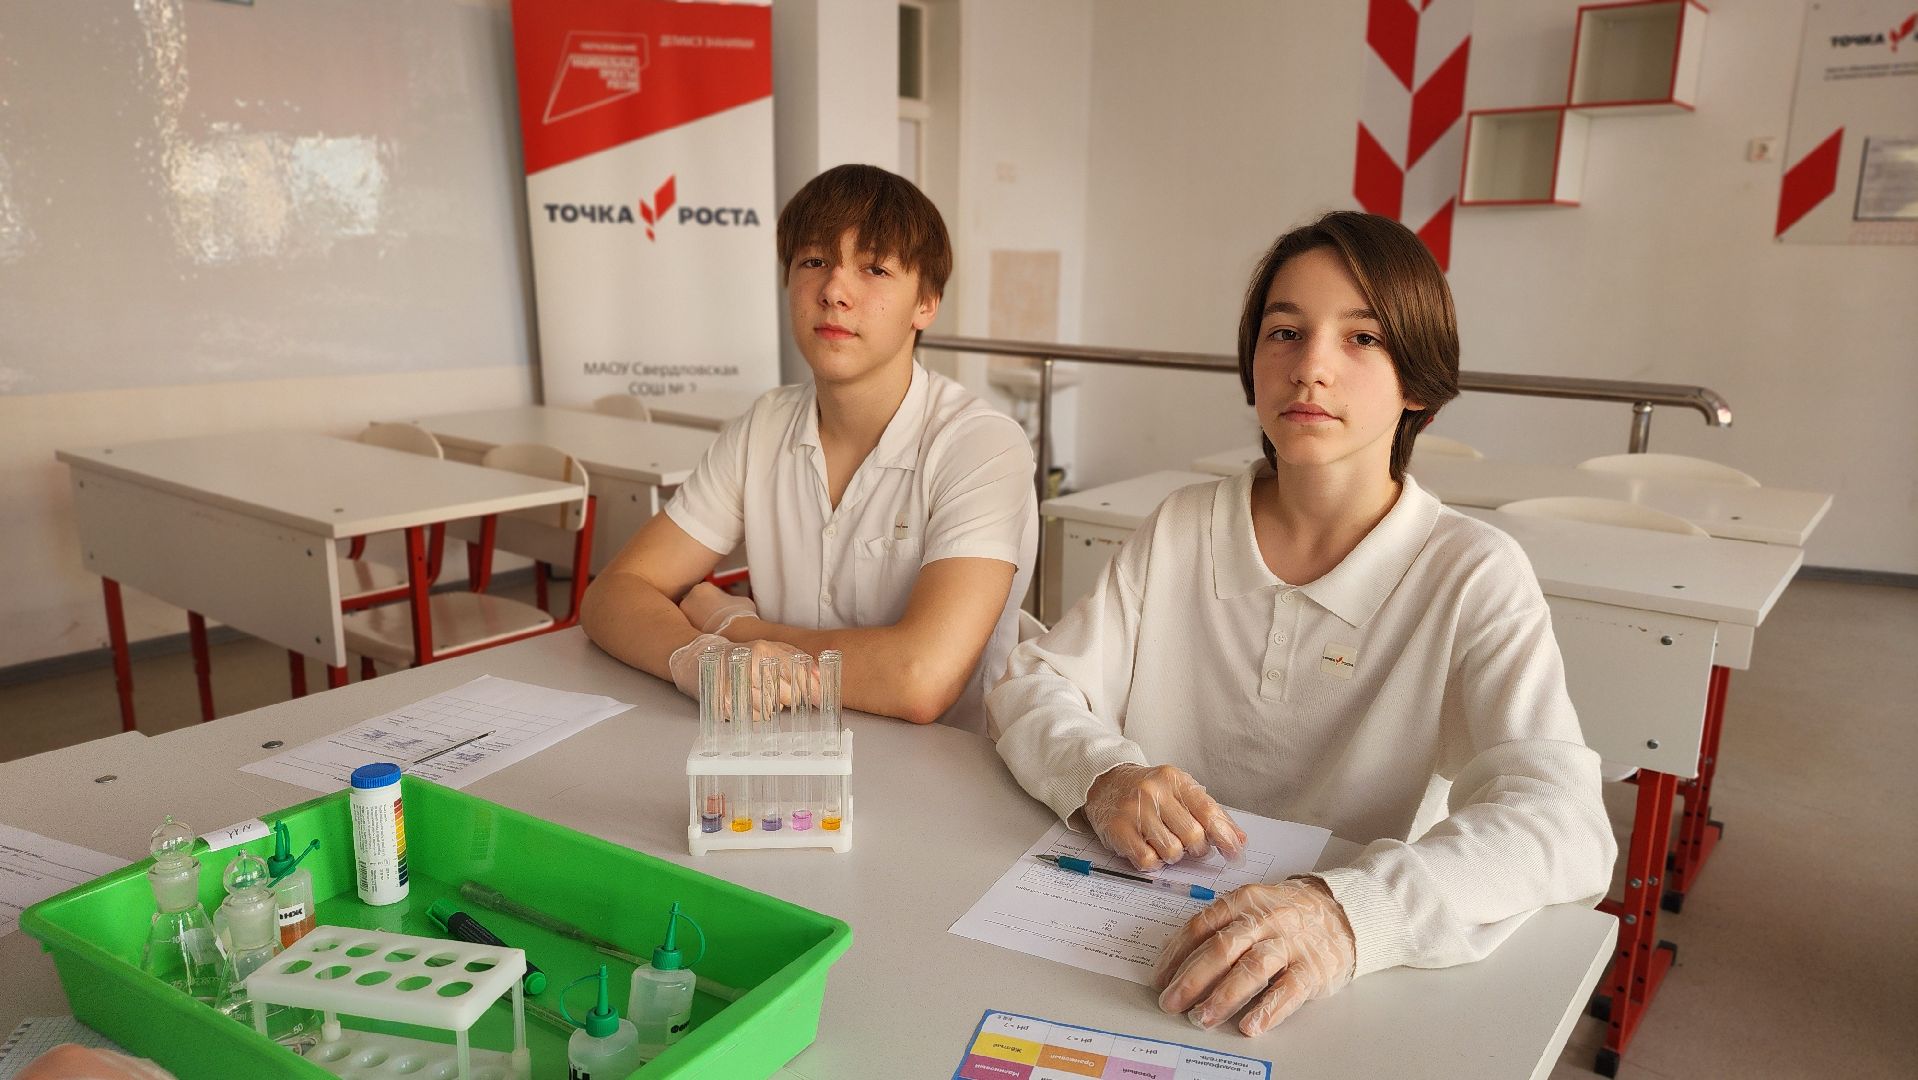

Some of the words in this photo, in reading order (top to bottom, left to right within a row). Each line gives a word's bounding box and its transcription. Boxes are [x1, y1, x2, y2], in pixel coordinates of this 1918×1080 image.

[544, 203, 634, 223] ТОЧКА
[678, 207, 760, 226] РОСТА
[583, 362, 629, 376] МАОУ
[631, 362, 739, 378] Свердловская
[628, 381, 666, 396] СОШ
[293, 1022, 304, 1034] 50
[1185, 1058, 1241, 1072] водородный
[1199, 1055, 1249, 1068] показатель
[1122, 1068, 1156, 1080] Розовый
